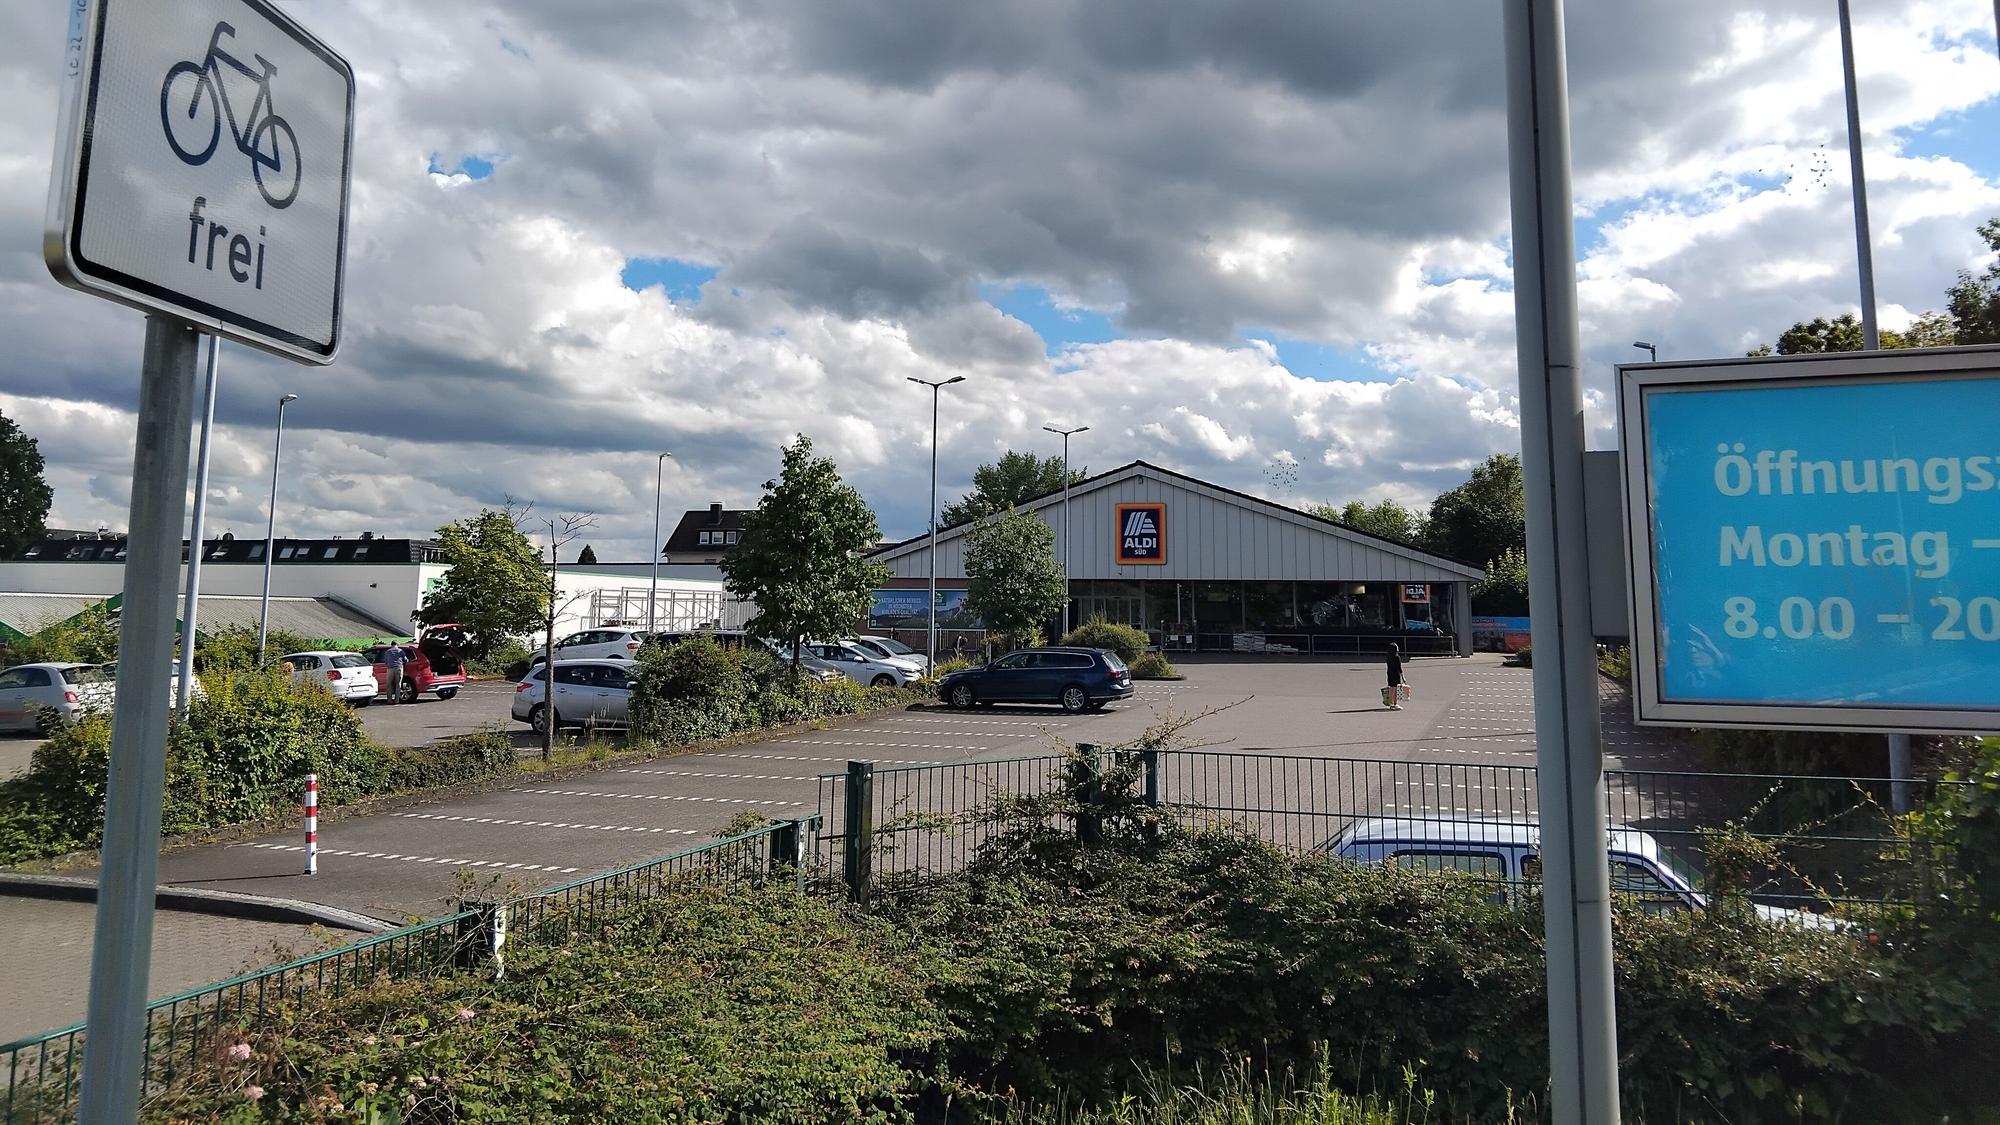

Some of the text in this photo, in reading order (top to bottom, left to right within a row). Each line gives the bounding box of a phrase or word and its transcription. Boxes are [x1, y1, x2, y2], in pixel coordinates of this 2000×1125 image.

[188, 196, 266, 290] frei
[1714, 442, 2000, 504] Öffnungs
[1124, 537, 1157, 548] ALDI
[1719, 525, 1949, 578] Montag
[1723, 596, 1856, 641] 8.00
[1931, 596, 2000, 641] 20
